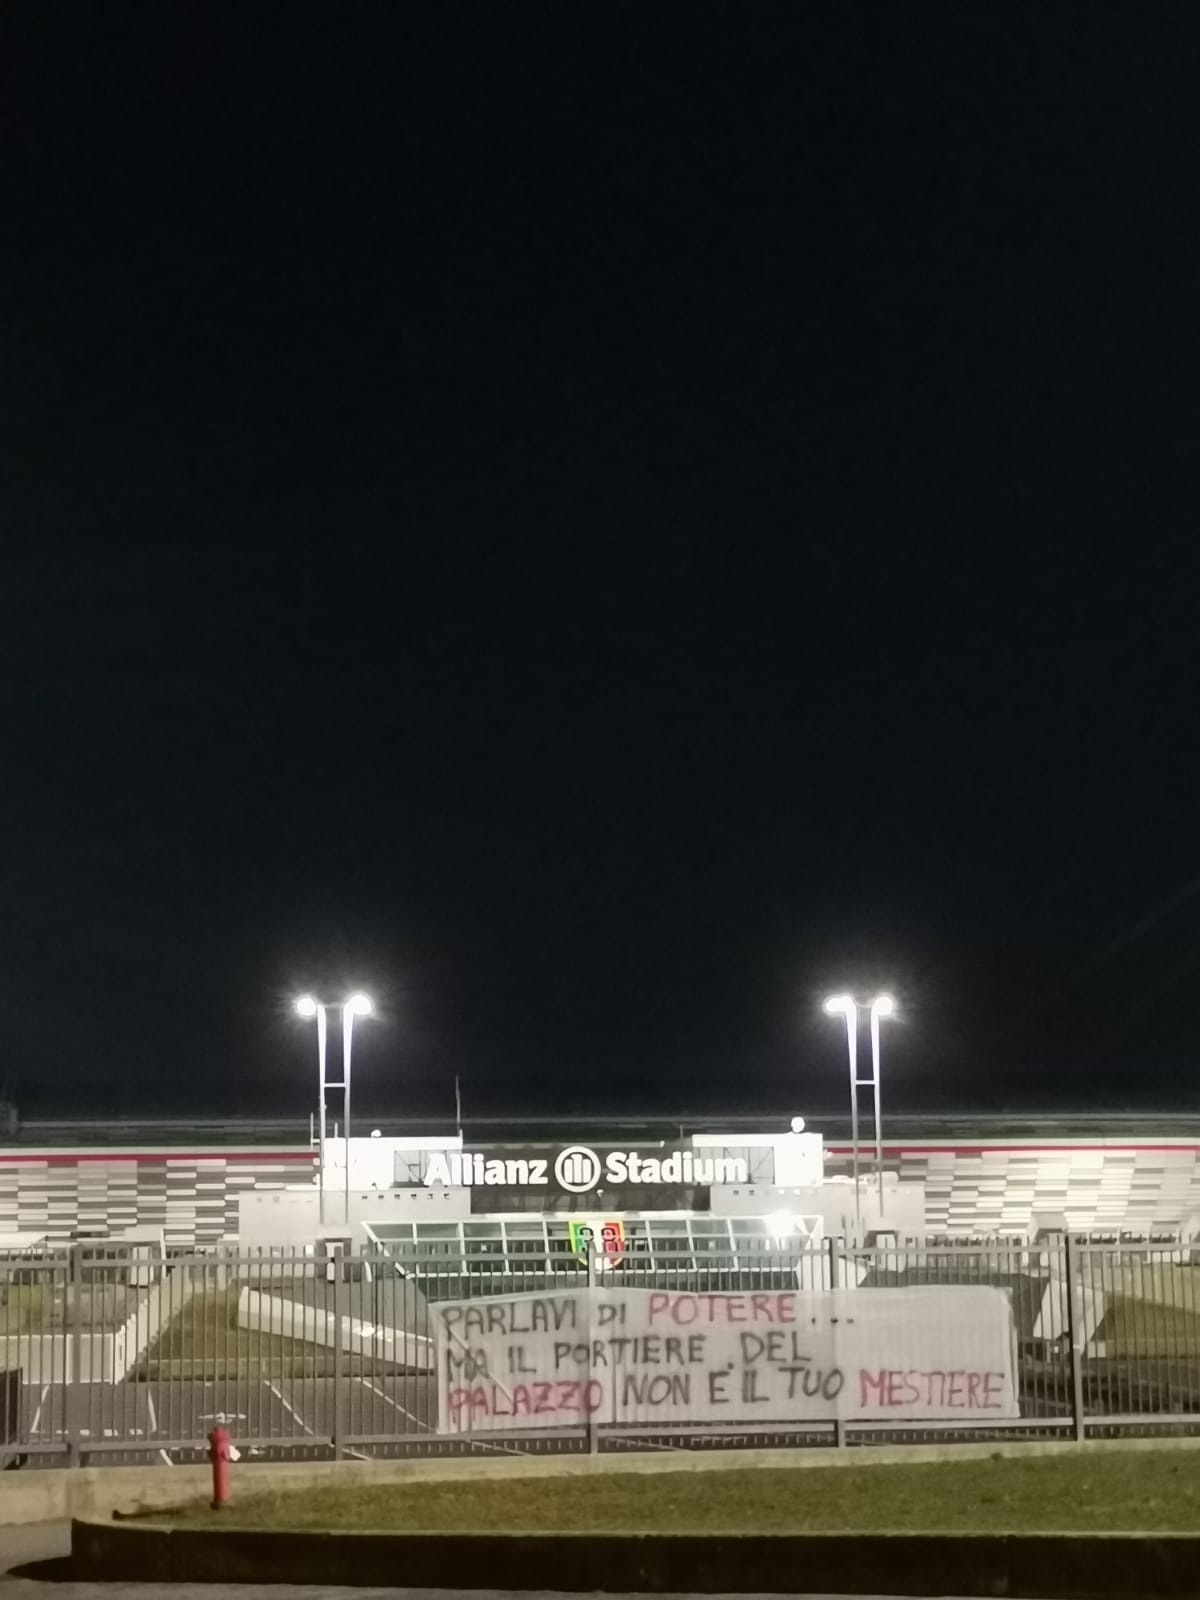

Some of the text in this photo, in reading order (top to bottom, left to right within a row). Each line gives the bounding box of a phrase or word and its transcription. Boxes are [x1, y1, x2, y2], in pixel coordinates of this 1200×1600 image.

[424, 1151, 748, 1186] Allianz Stadium
[441, 1300, 576, 1340] PARLAVI
[598, 1303, 627, 1326] DI
[447, 1330, 812, 1383] MA IL PORTIERE DEL
[448, 1380, 602, 1422] PALAZZO
[623, 1373, 691, 1408] NON
[743, 1369, 770, 1404] IL
[778, 1366, 845, 1402] TUO
[860, 1369, 1005, 1409] MESTIERE
